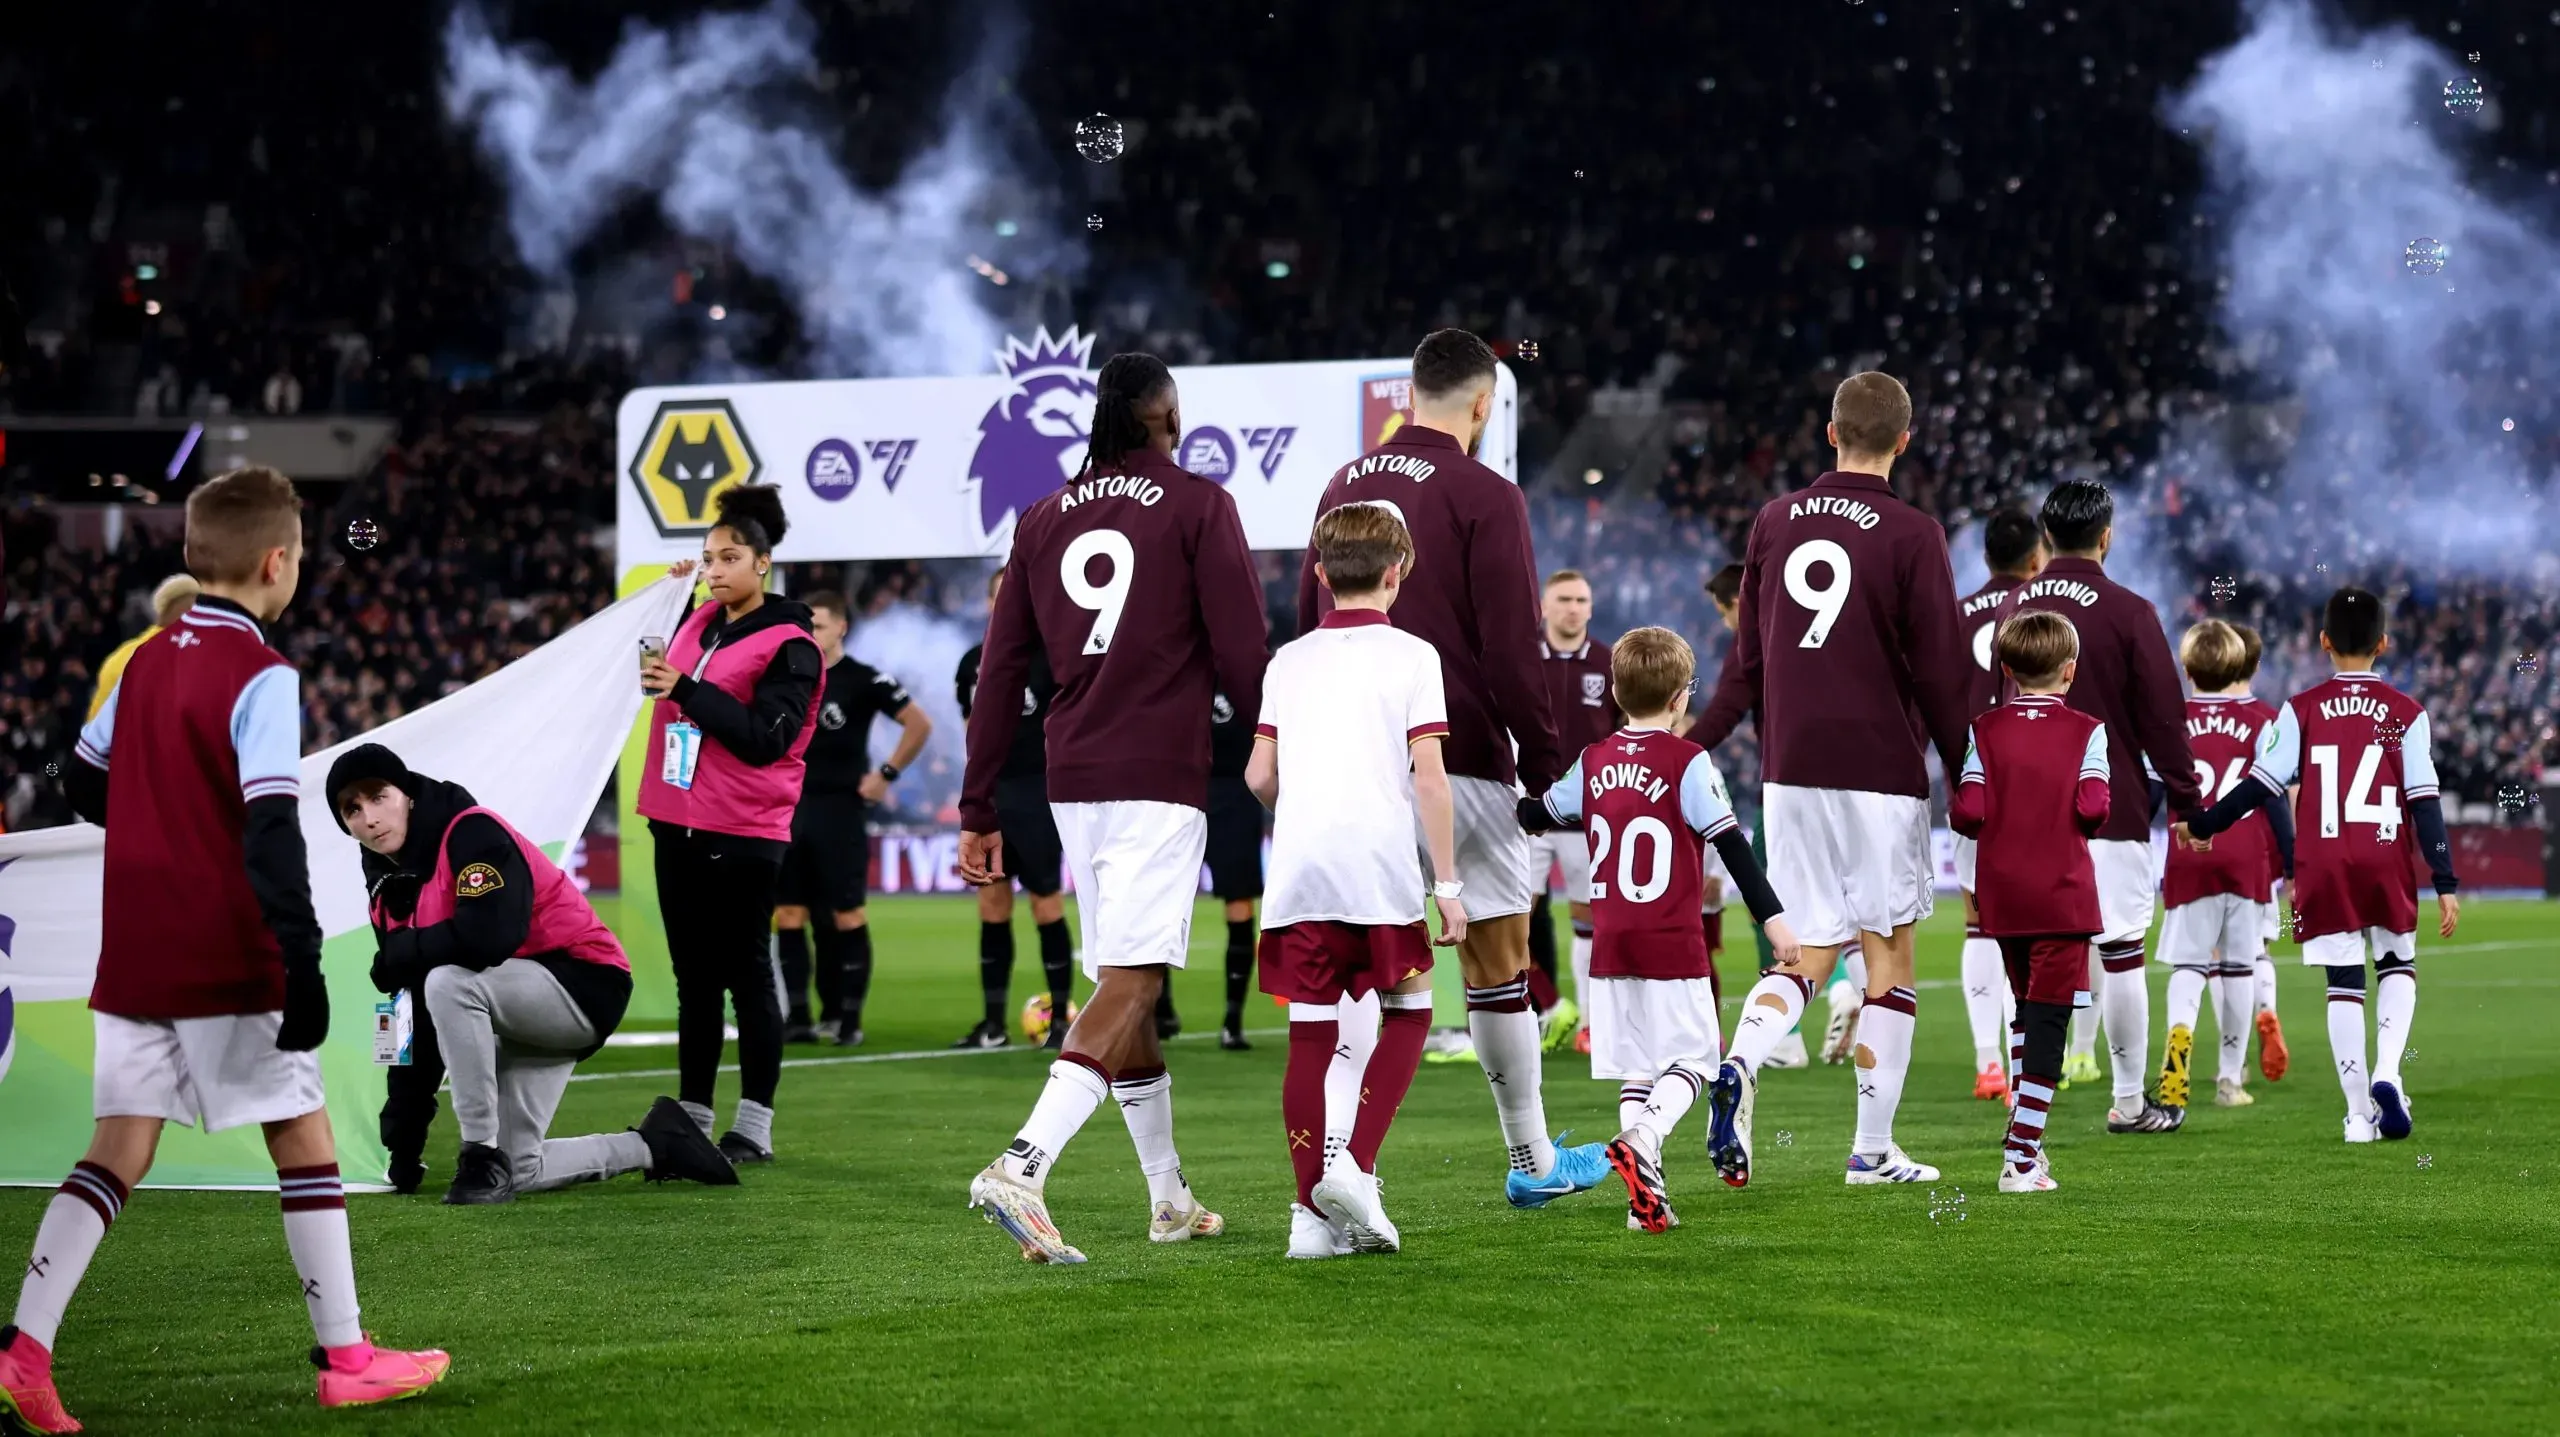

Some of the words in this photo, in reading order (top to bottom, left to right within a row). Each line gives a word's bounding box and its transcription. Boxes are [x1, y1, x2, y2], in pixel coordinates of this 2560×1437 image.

[814, 449, 853, 476] EA
[1188, 438, 1229, 464] EA
[1345, 455, 1436, 485] ANTONIO
[1061, 475, 1164, 512] ANTONIO
[1789, 497, 1881, 530] ANTONIO
[1060, 528, 1135, 655] 9
[1783, 539, 1852, 648] 9
[2017, 579, 2099, 607] ANTONIO
[2319, 696, 2389, 723] KUDUS
[2186, 715, 2252, 743] ILMAN
[1589, 763, 1670, 804] BOWEN
[2310, 744, 2403, 840] 14
[461, 865, 495, 881] ZAVETTI
[1589, 813, 1673, 903] 20
[461, 881, 496, 894] CANADA
